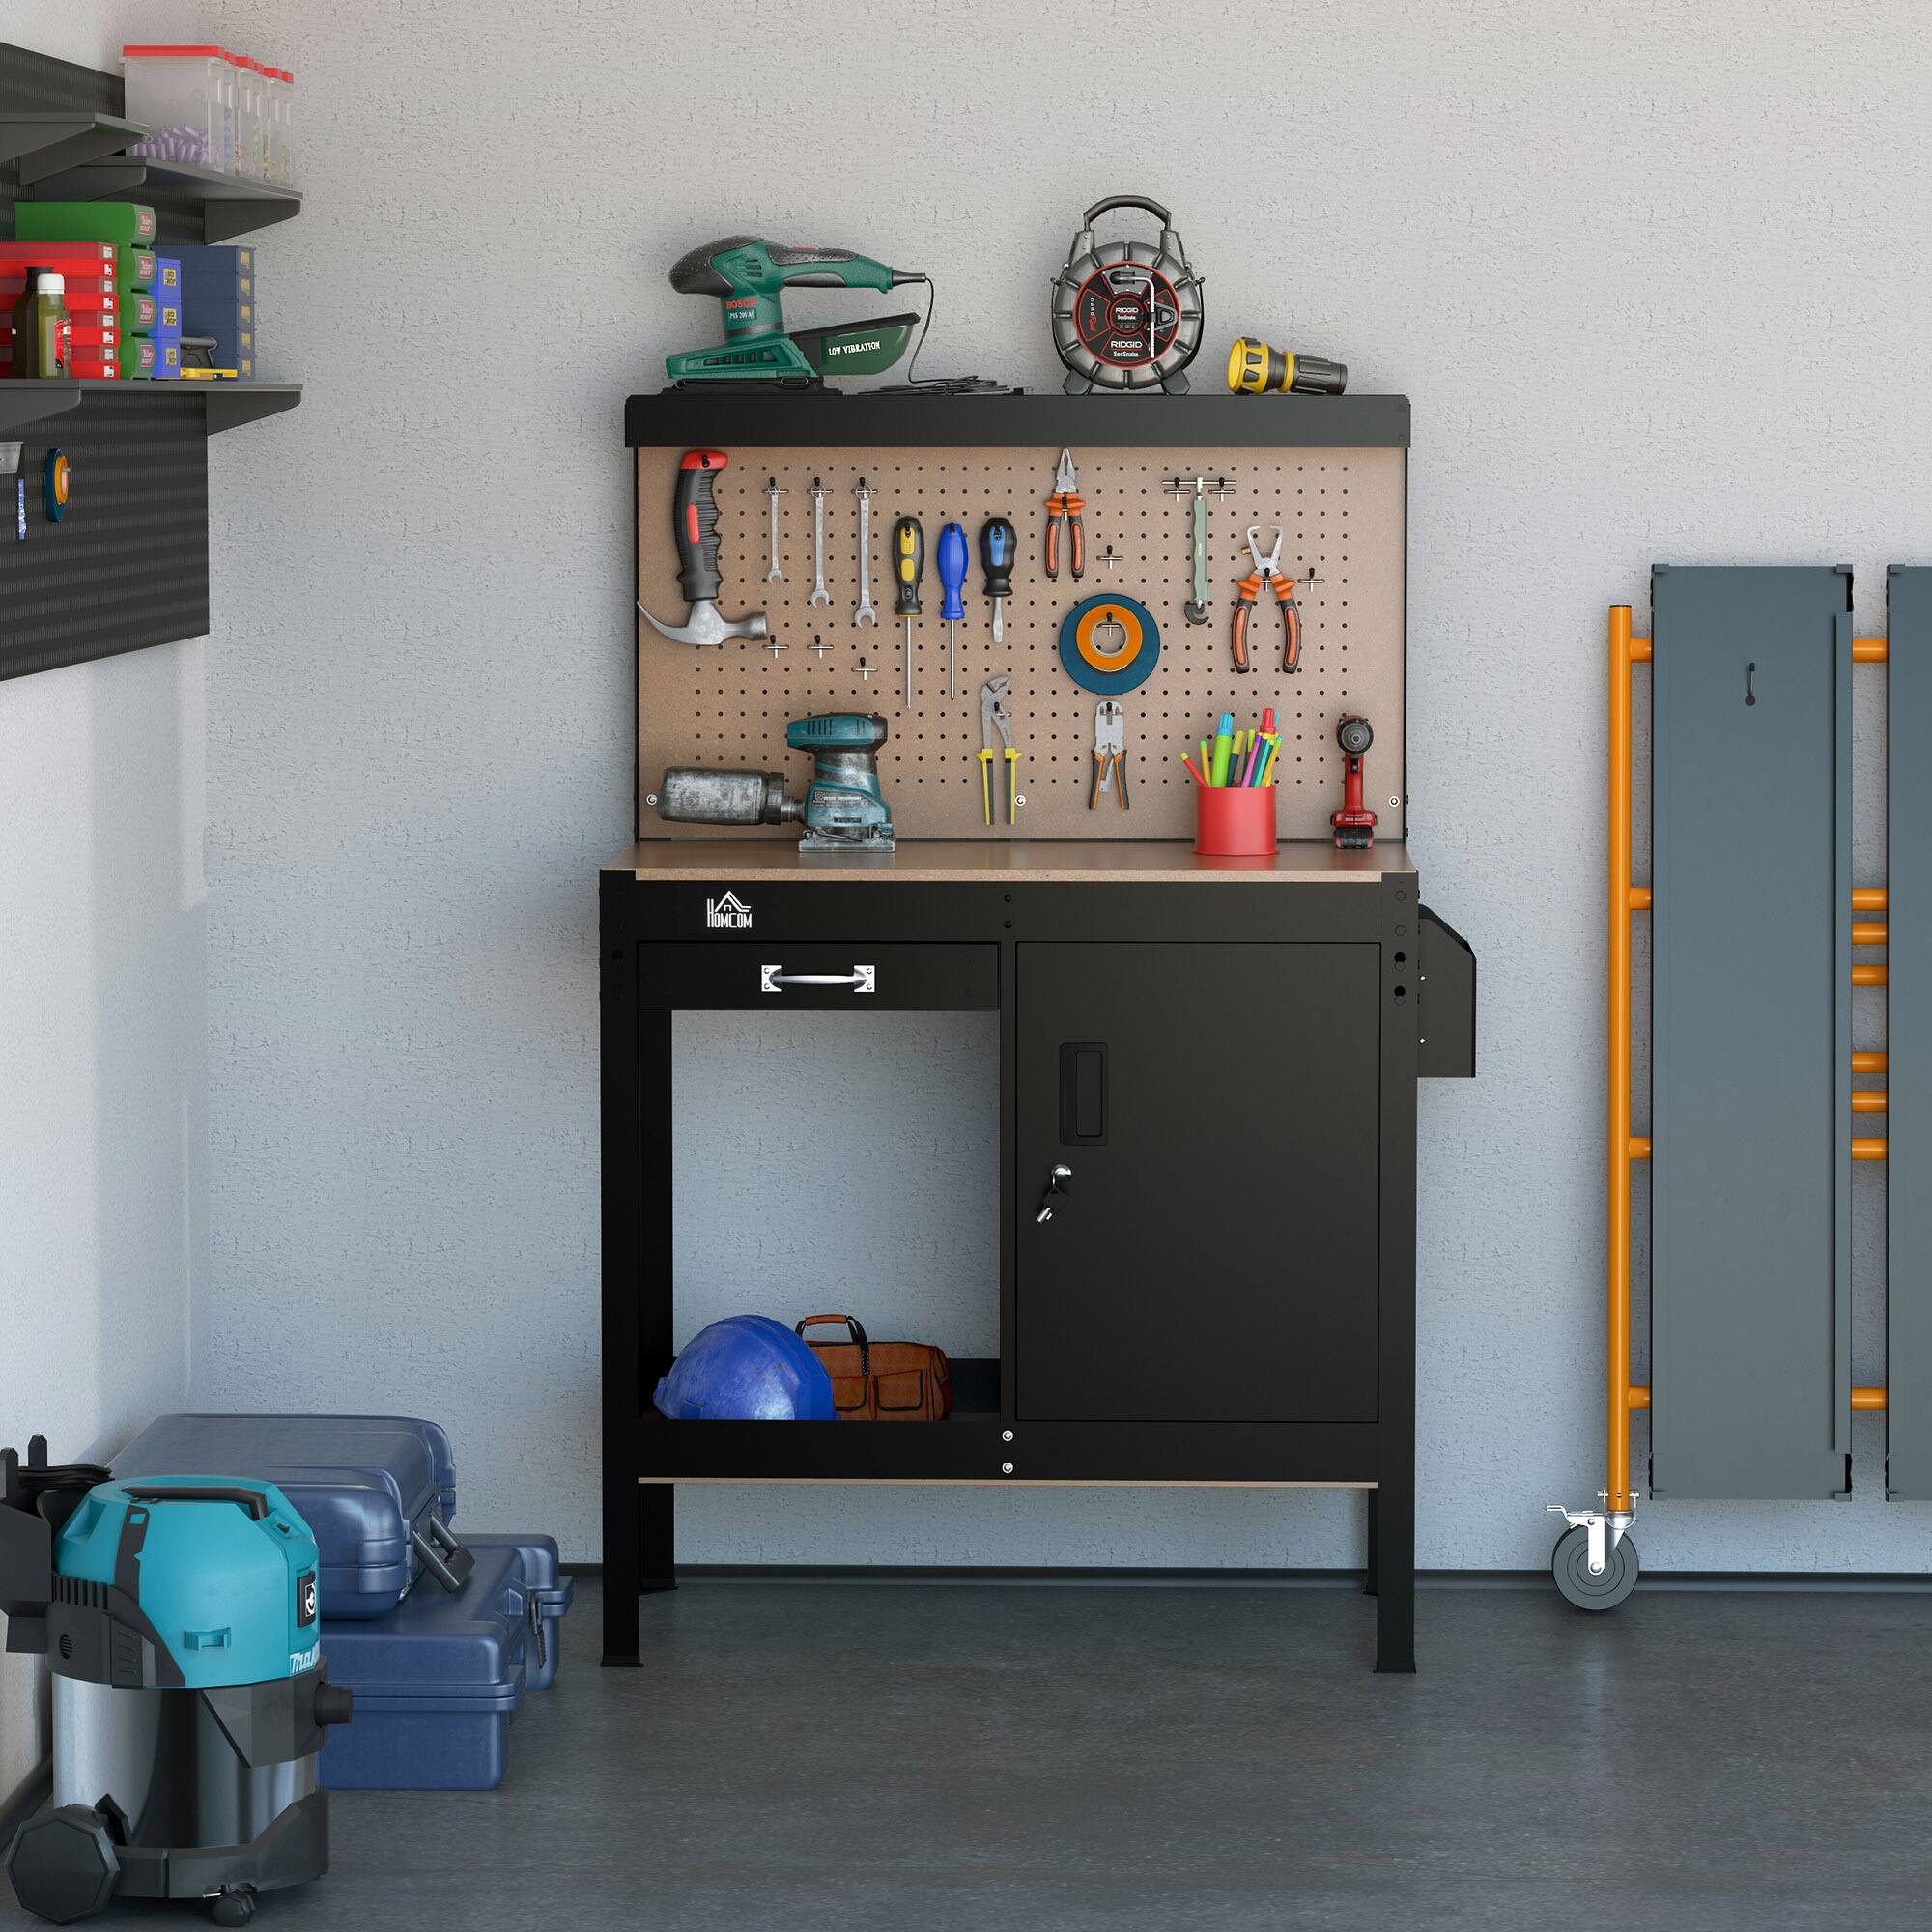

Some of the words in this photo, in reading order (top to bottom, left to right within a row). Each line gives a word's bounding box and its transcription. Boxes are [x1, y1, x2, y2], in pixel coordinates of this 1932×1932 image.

[726, 298, 756, 309] BOSCH
[828, 347, 841, 356] LOW
[842, 341, 881, 354] VIBRATION
